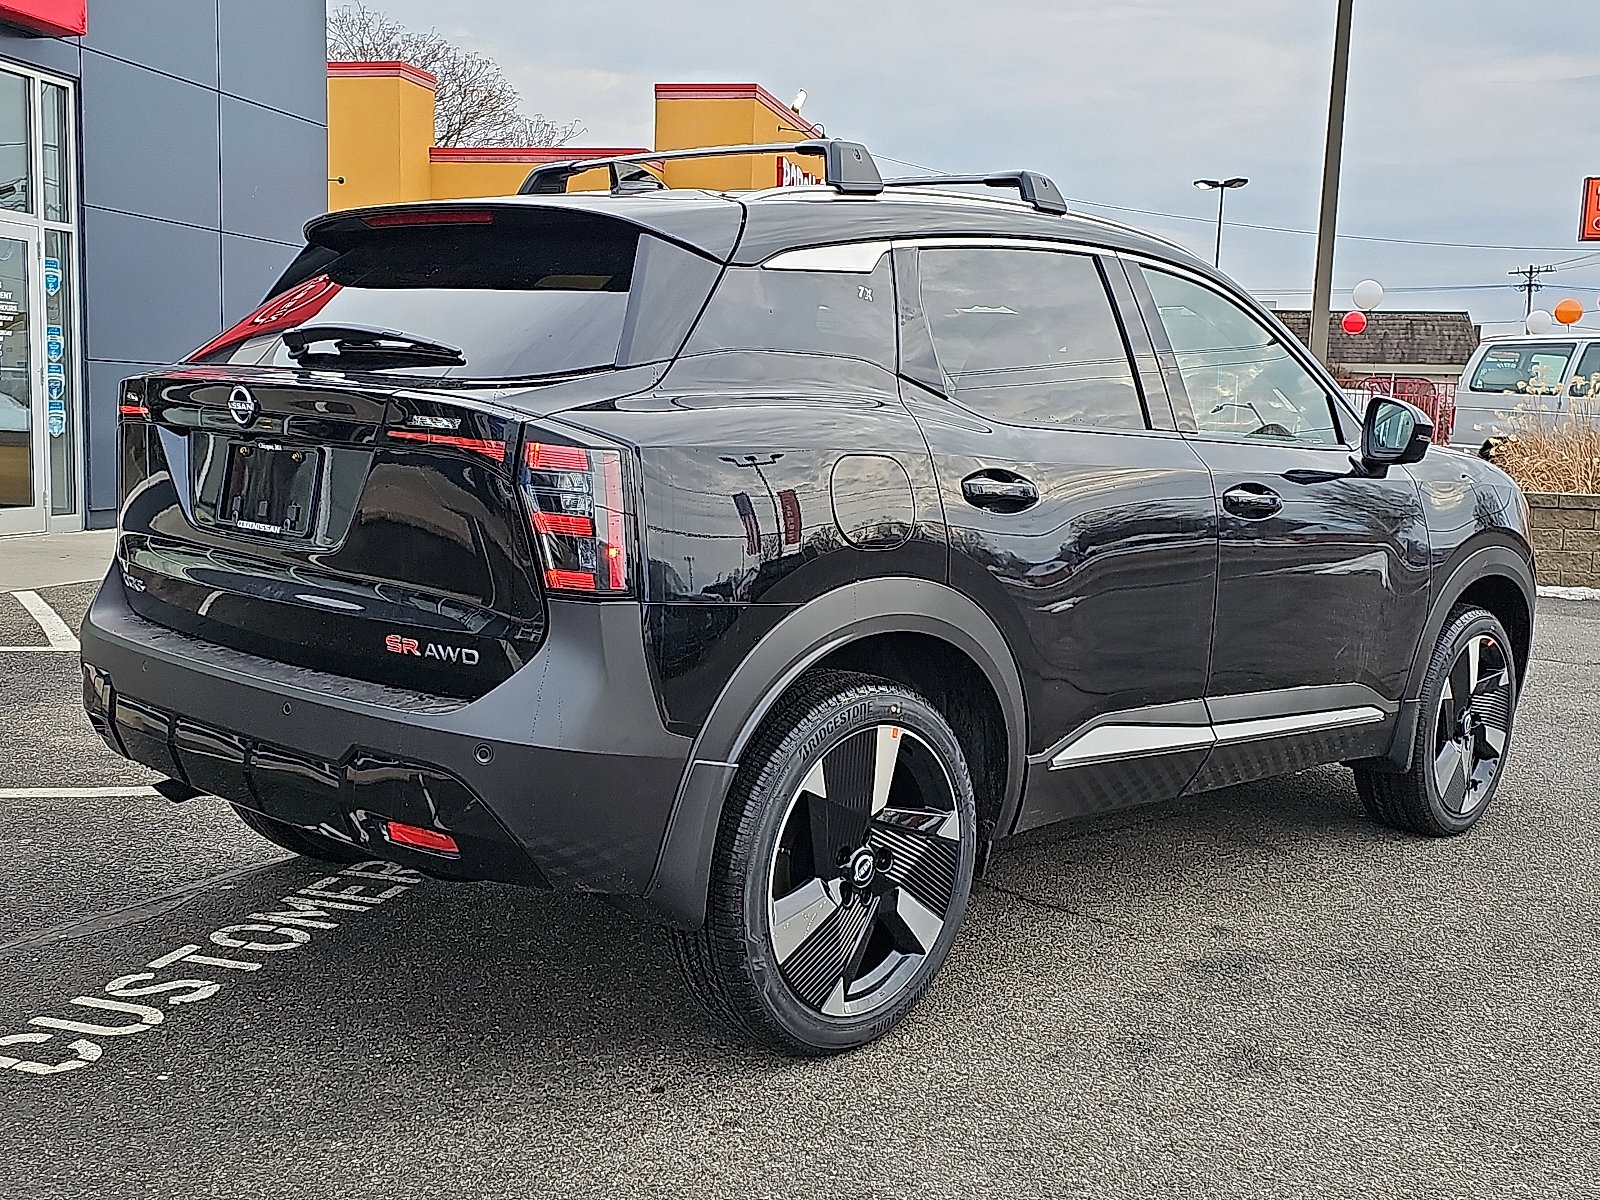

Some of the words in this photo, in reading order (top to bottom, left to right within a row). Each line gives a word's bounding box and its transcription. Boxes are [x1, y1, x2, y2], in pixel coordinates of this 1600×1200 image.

[385, 634, 421, 656] SR
[424, 642, 480, 665] AWD
[798, 700, 874, 763] BRIDGESTONE
[0, 860, 422, 1075] CUSTOMER
